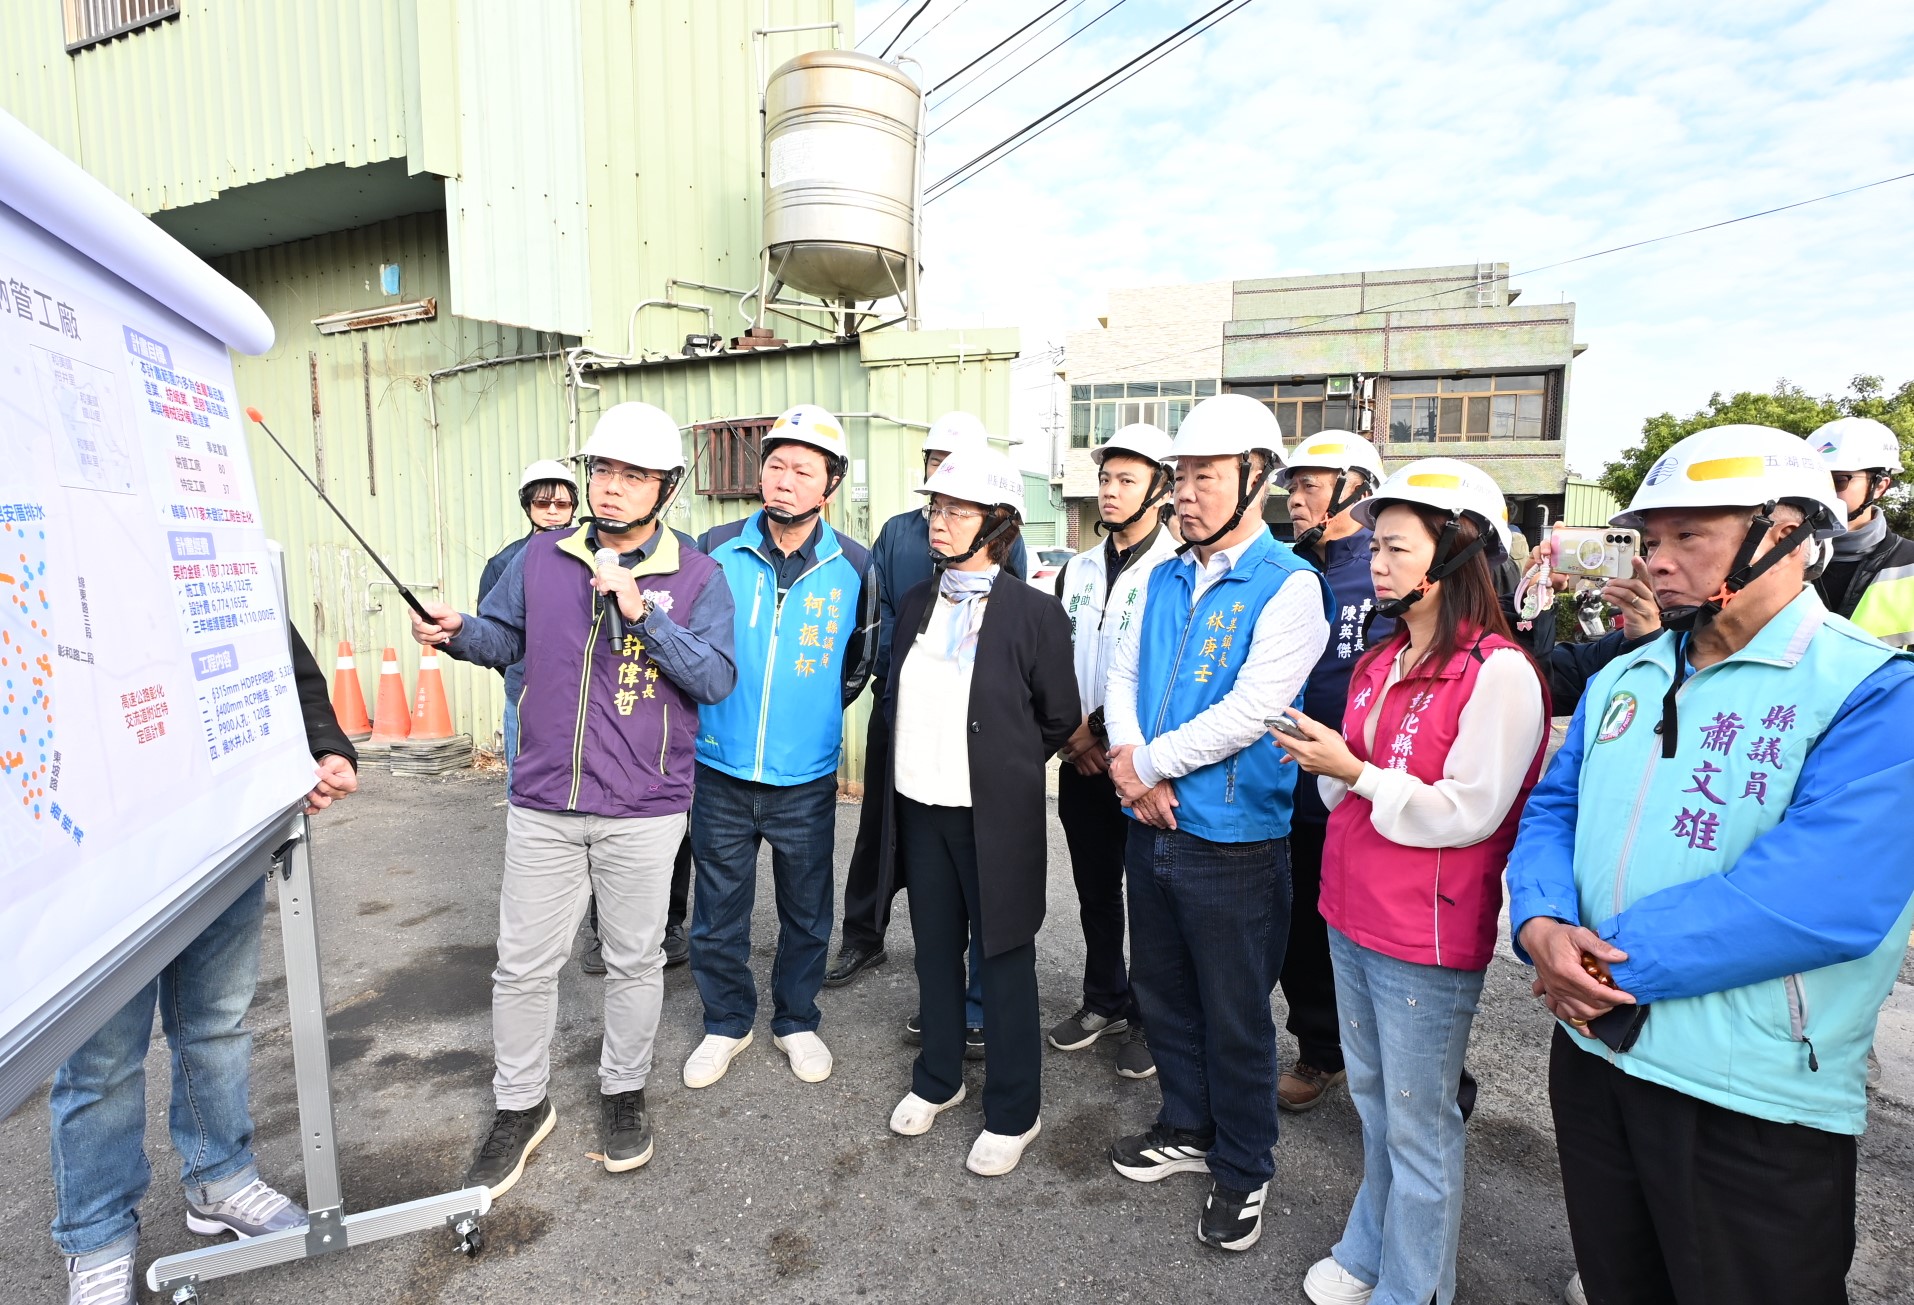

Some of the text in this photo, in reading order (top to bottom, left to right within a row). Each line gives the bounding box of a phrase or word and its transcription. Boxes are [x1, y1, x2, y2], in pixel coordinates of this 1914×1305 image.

[794, 592, 826, 678] 柯振杯
[820, 587, 842, 668] 彰化縣議員
[1080, 582, 1093, 606] 特助
[1218, 601, 1245, 668] 和美鎮長
[1336, 604, 1357, 659] 陳英傑
[613, 633, 646, 716] 許偉哲
[1670, 712, 1745, 851] 蕭文雄
[1738, 704, 1797, 806] 縣議員
